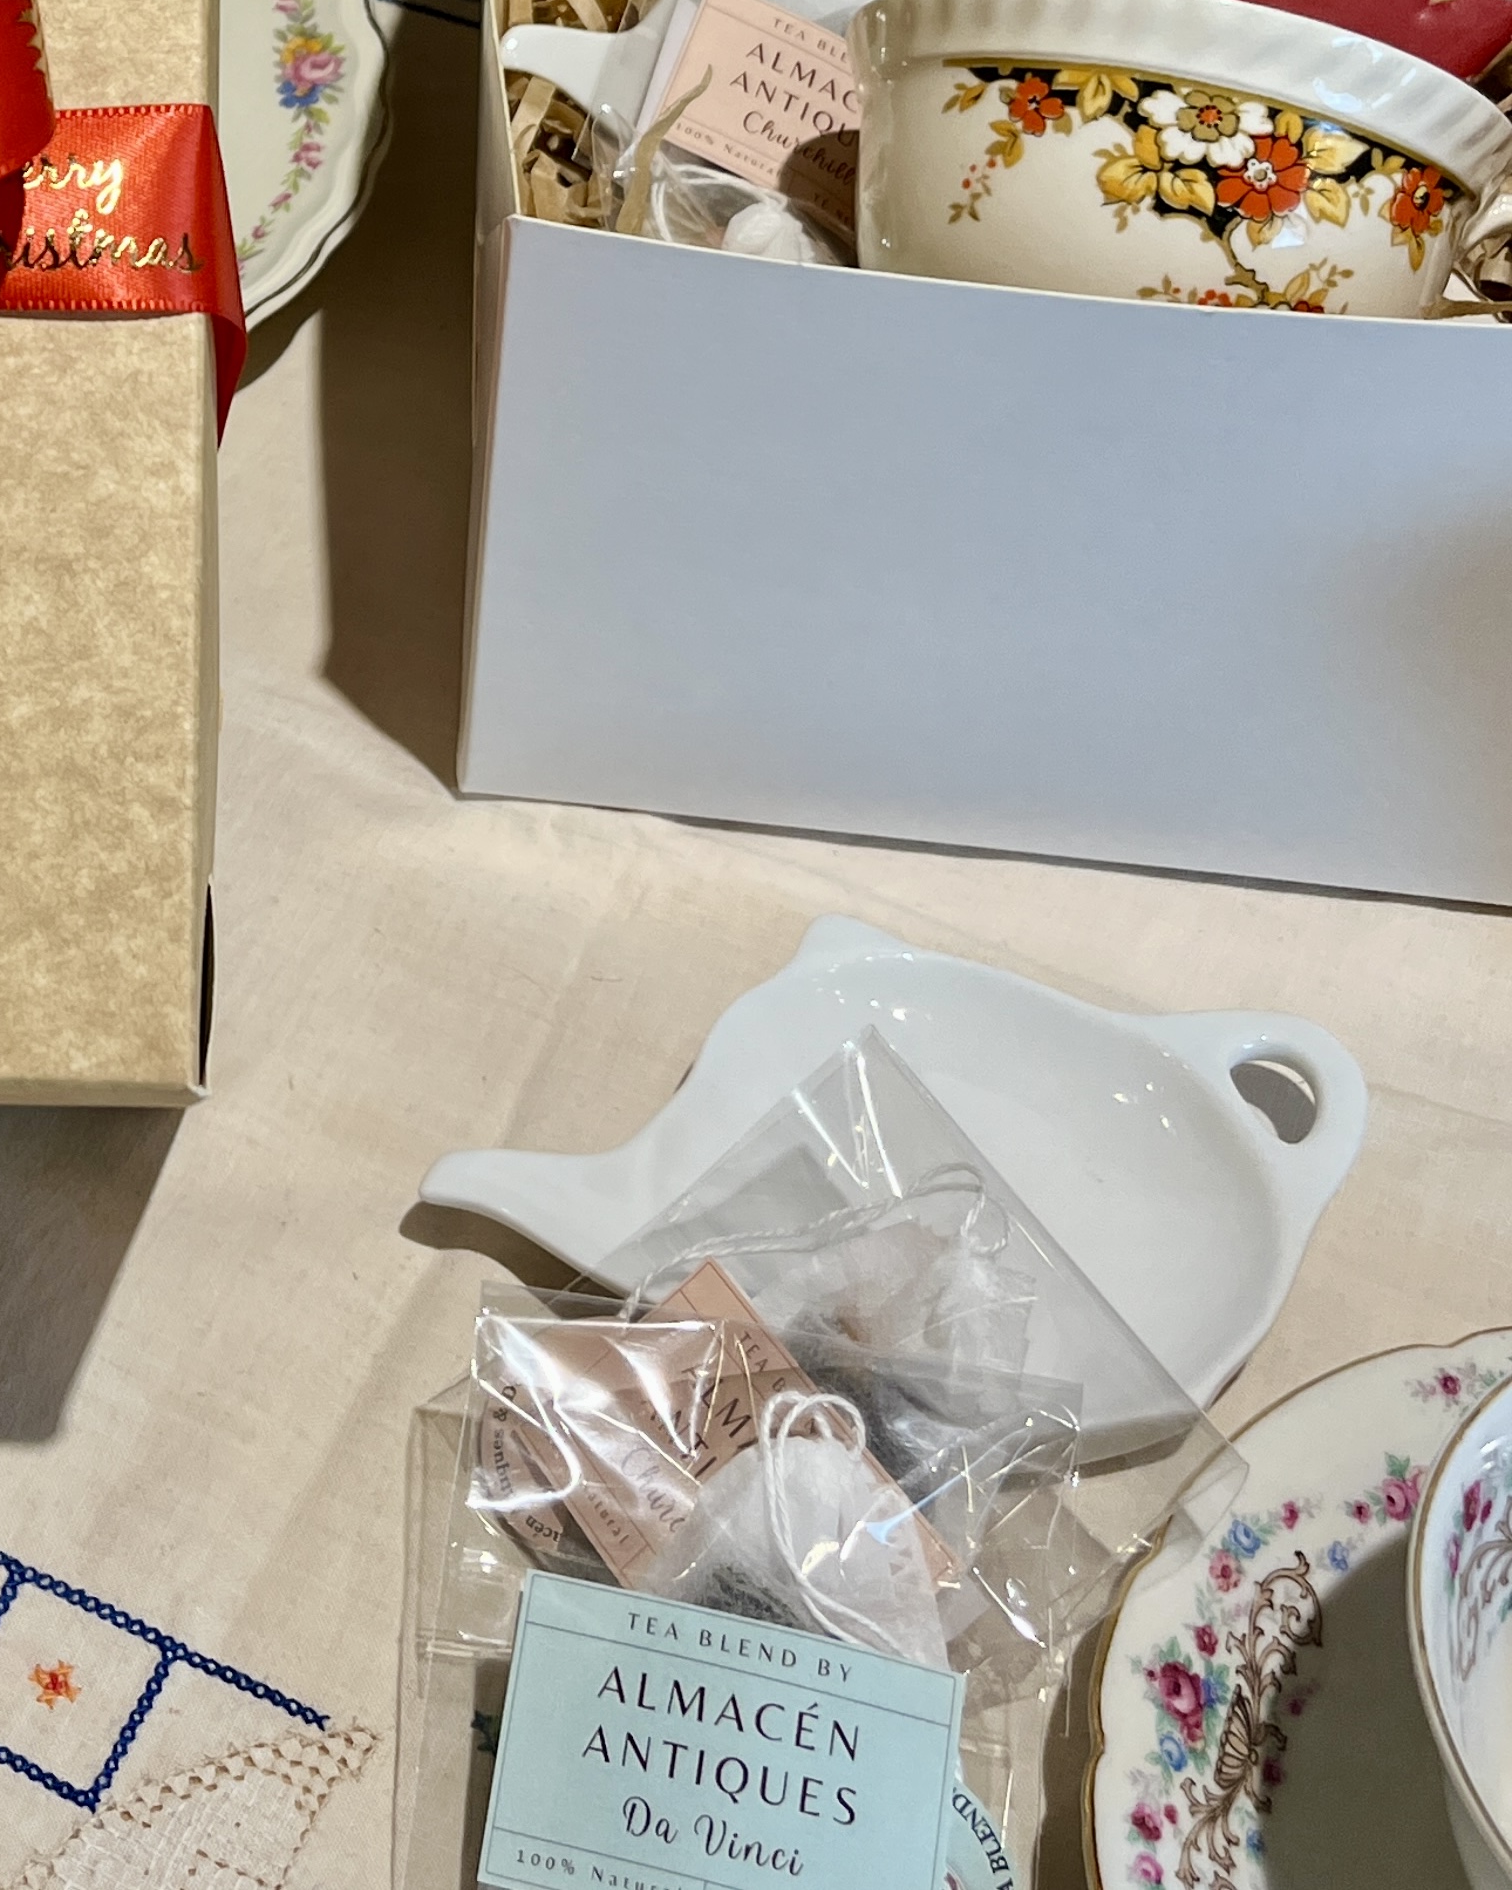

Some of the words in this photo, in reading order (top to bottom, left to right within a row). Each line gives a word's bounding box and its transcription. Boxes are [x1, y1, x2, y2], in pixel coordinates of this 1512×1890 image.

[773, 17, 805, 42] TEA
[729, 70, 857, 148] ANTIQU
[745, 42, 859, 115] ALMAC
[23, 154, 123, 215] erry
[739, 1330, 770, 1374] TEA
[628, 1611, 679, 1641] TEA
[699, 1628, 798, 1668] BLEND
[817, 1657, 853, 1683] BY
[597, 1665, 860, 1762] ALMACÉN
[582, 1724, 857, 1826] ANTIQUES
[516, 1849, 576, 1876] 100%
[622, 1795, 679, 1845] Da
[693, 1813, 805, 1876] Vinci
[950, 1786, 1010, 1875] BLEND
